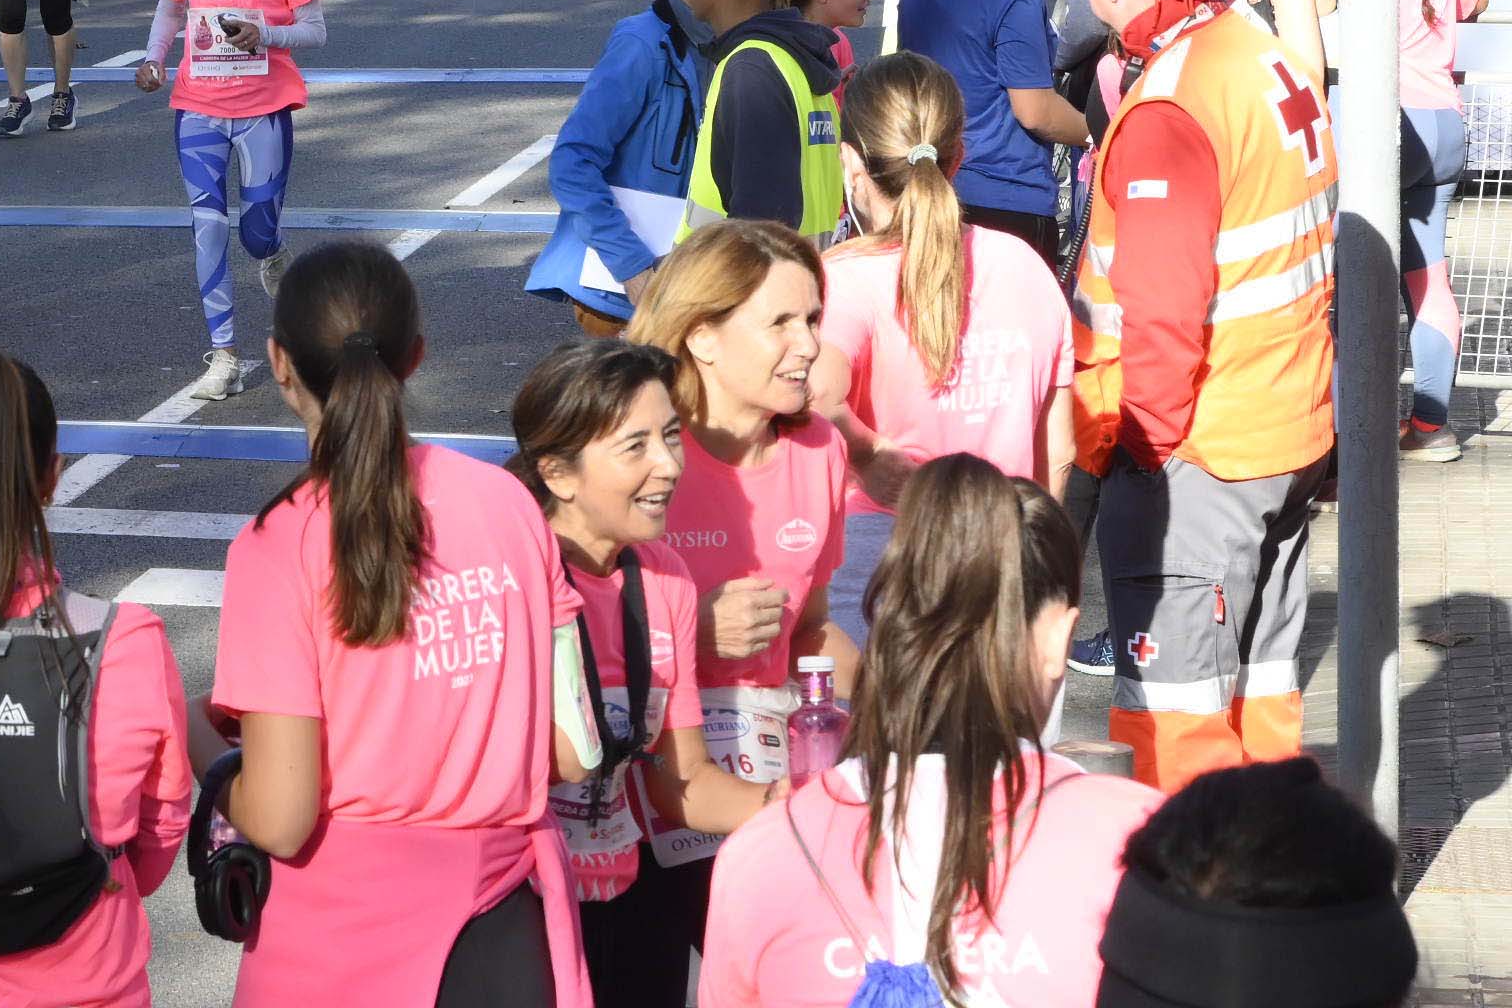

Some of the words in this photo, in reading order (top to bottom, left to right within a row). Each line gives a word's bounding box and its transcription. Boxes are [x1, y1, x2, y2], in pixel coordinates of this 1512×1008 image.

[410, 561, 519, 611] ARRERA
[415, 609, 454, 646] DE
[463, 599, 501, 635] LA
[712, 754, 754, 775] 16
